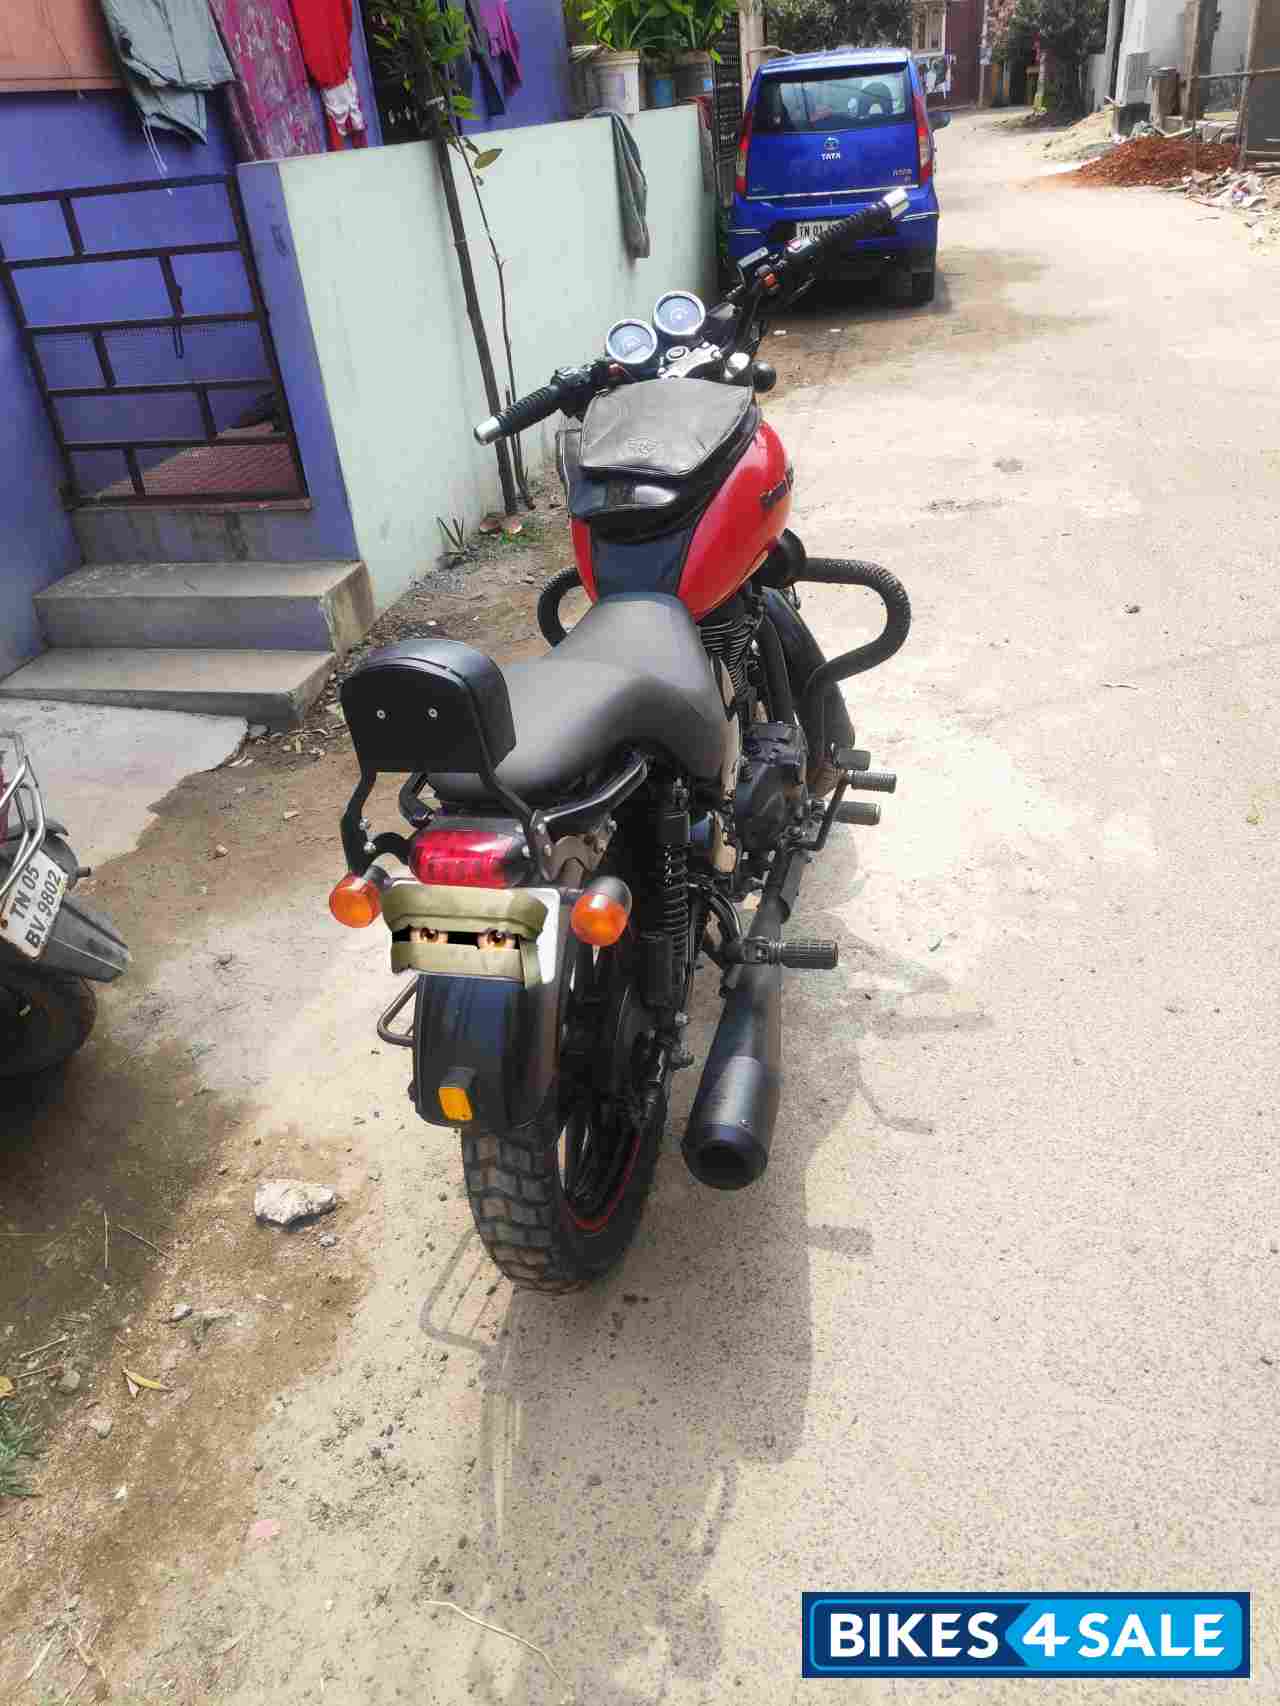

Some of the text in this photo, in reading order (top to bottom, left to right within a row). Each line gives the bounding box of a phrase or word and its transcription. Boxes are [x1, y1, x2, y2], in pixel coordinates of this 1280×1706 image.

[821, 152, 841, 160] TATA
[14, 864, 40, 919] TN 05
[25, 869, 62, 948] BV 9802
